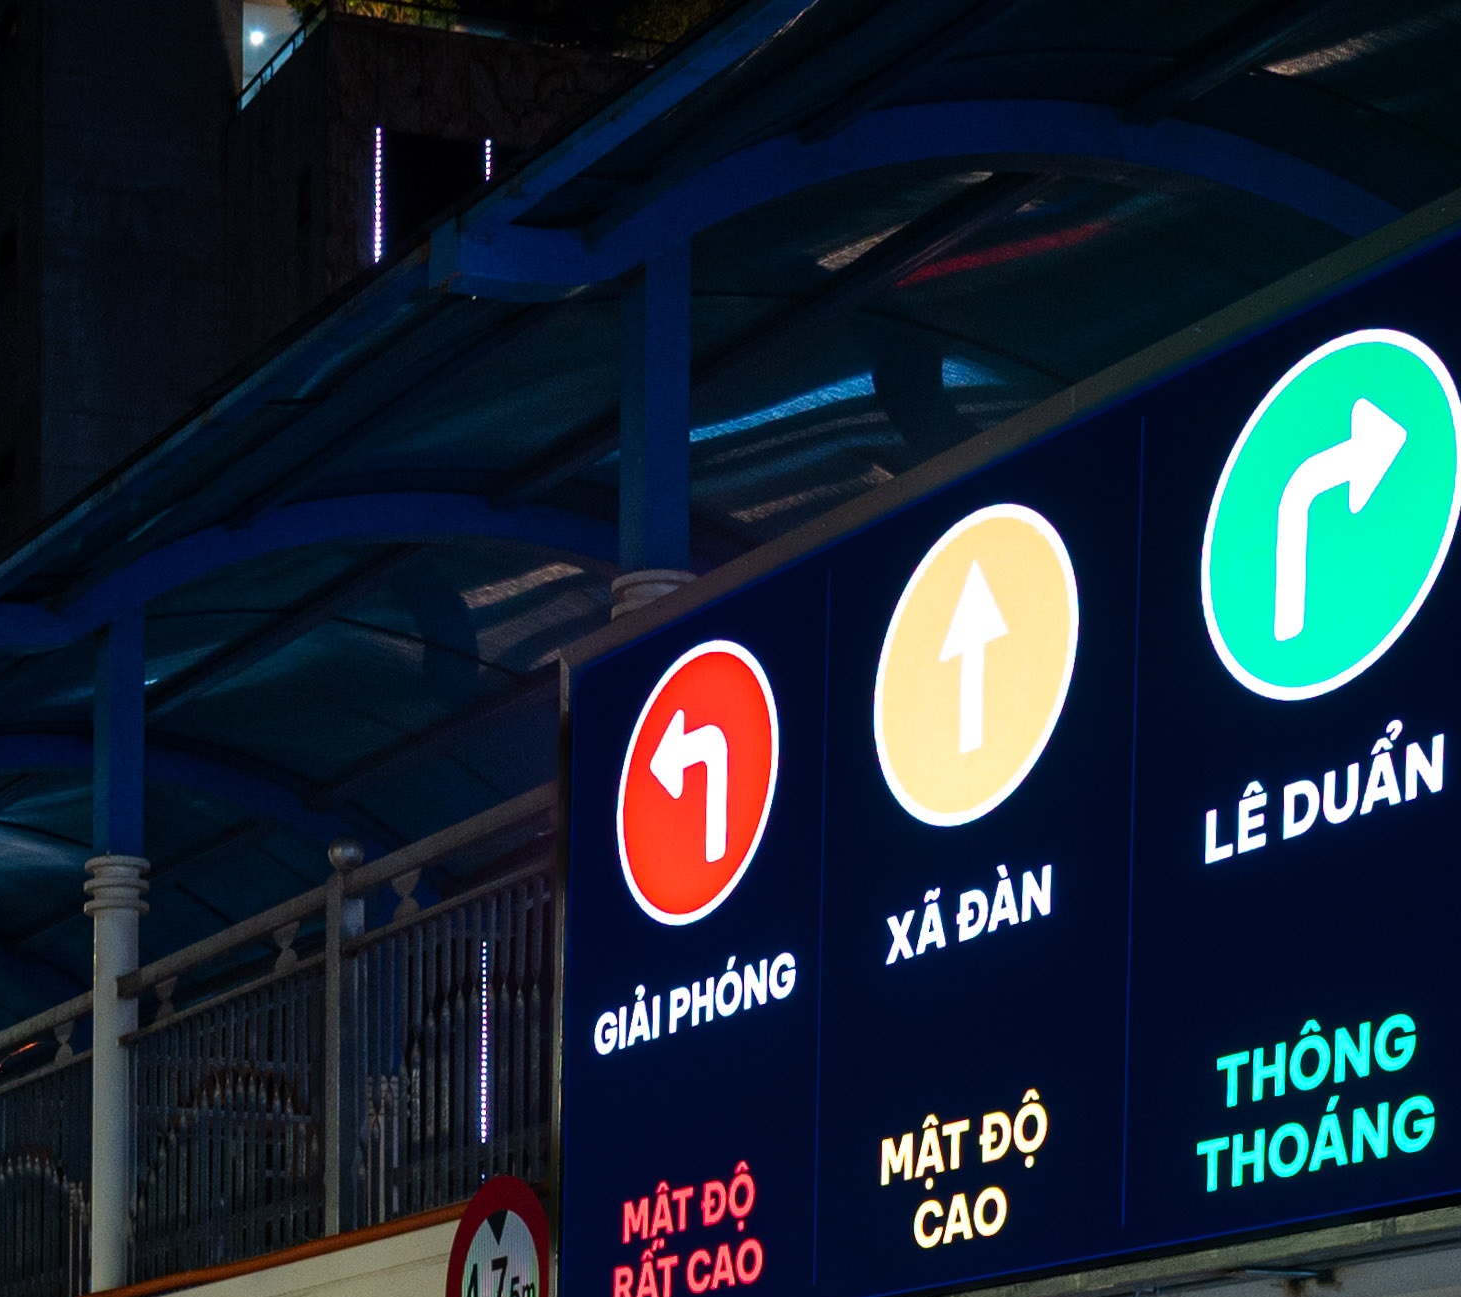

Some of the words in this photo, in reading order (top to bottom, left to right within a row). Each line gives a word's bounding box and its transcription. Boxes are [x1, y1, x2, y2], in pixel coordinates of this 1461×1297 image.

[1204, 779, 1268, 865] LÊ
[1282, 719, 1445, 842] DUẨN
[885, 886, 947, 966] XÃ
[955, 863, 1053, 943] ĐÀN
[593, 984, 662, 1056] GIẢI
[668, 951, 797, 1035] PHÓNG
[1216, 1013, 1417, 1108] THÔNG
[880, 1112, 970, 1190] MẬT
[979, 1088, 1048, 1169] ĐỘ
[1196, 1095, 1436, 1193] THOÁNG
[622, 1180, 694, 1246] MẬT
[700, 1160, 756, 1232] ĐỘ
[913, 1186, 1008, 1249] CAO
[686, 1238, 764, 1294] CAO
